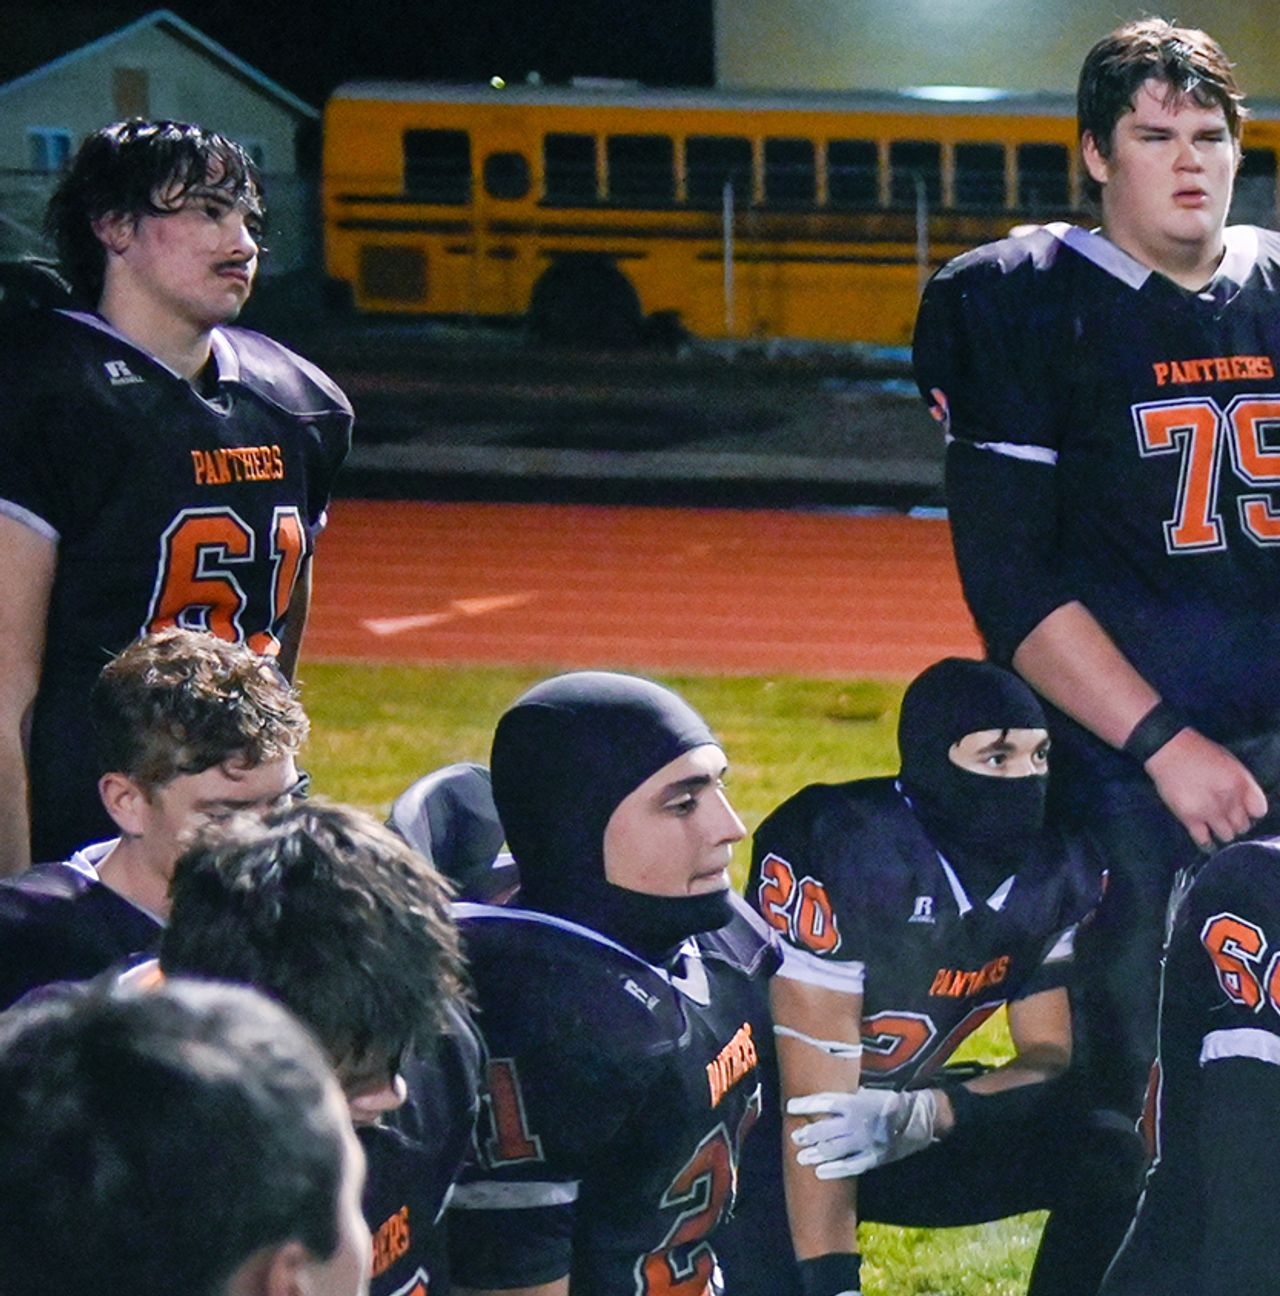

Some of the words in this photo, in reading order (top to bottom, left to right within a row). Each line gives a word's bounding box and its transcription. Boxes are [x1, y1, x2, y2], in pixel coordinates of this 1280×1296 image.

[1153, 355, 1275, 386] PANTHERS
[191, 444, 284, 486] PANTHERS
[141, 505, 307, 657] 61
[759, 852, 842, 954] 20
